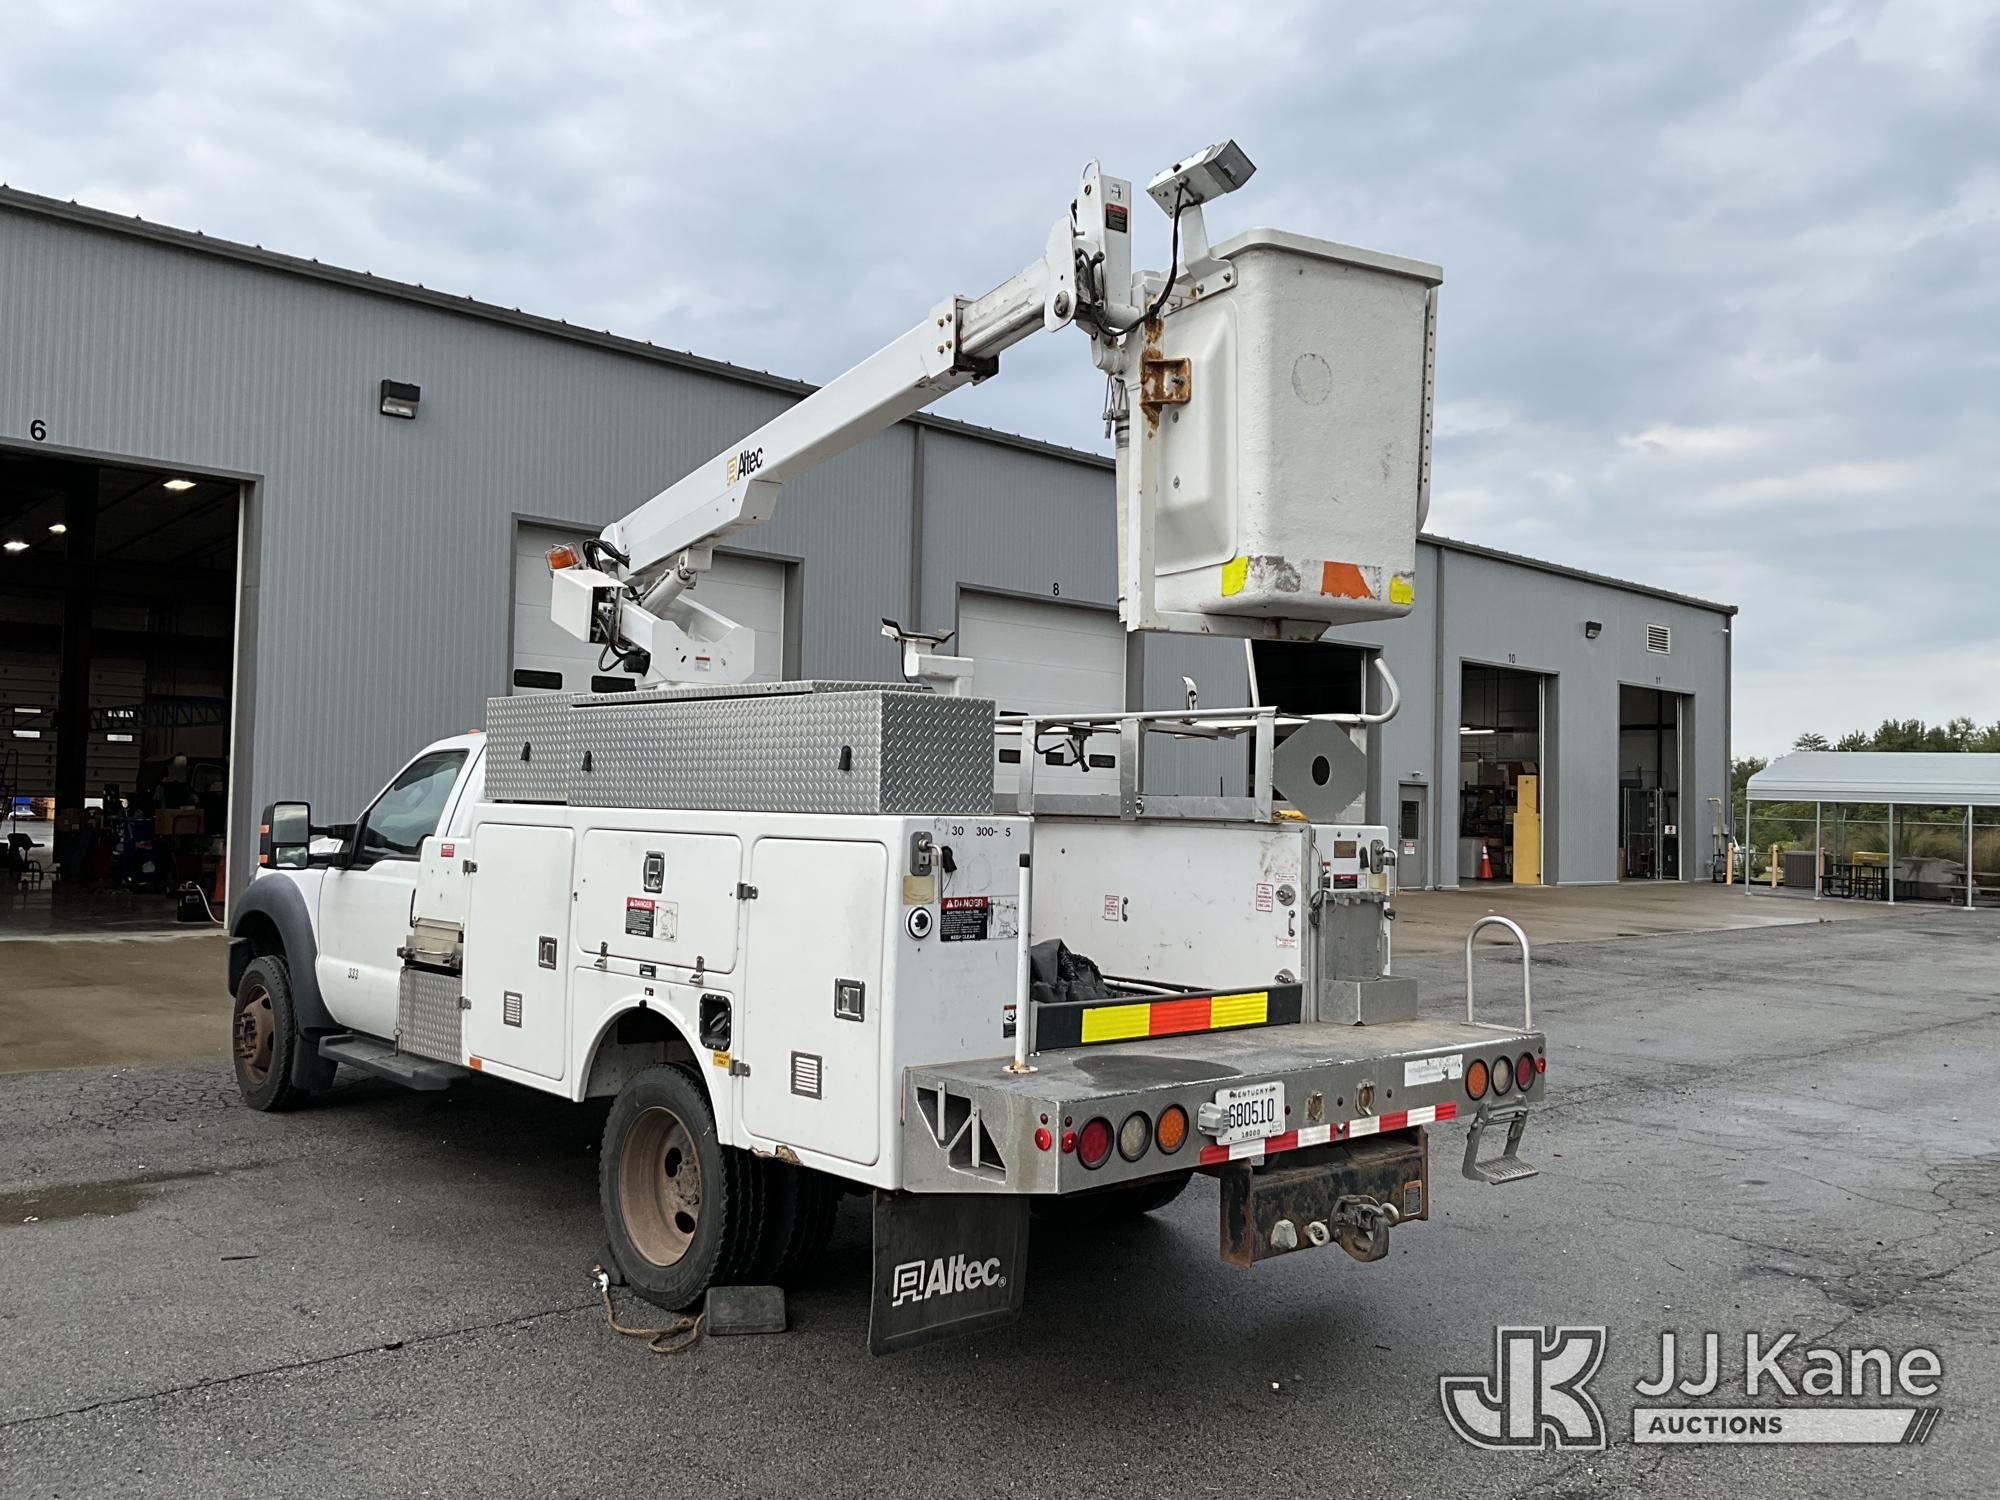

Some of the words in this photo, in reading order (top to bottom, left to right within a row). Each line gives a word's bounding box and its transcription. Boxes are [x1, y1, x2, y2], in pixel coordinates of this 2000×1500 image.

[30, 419, 47, 441] 6
[737, 447, 763, 480] Altec
[1053, 582, 1060, 596] 8
[1508, 653, 1516, 664] 10
[1655, 676, 1661, 685] 11
[951, 826, 964, 836] 30
[1005, 827, 1011, 837] 5
[634, 900, 653, 909] DANGER
[954, 899, 983, 908] DANGER
[1228, 1098, 1274, 1128] 680510
[924, 1253, 1001, 1299] Altec
